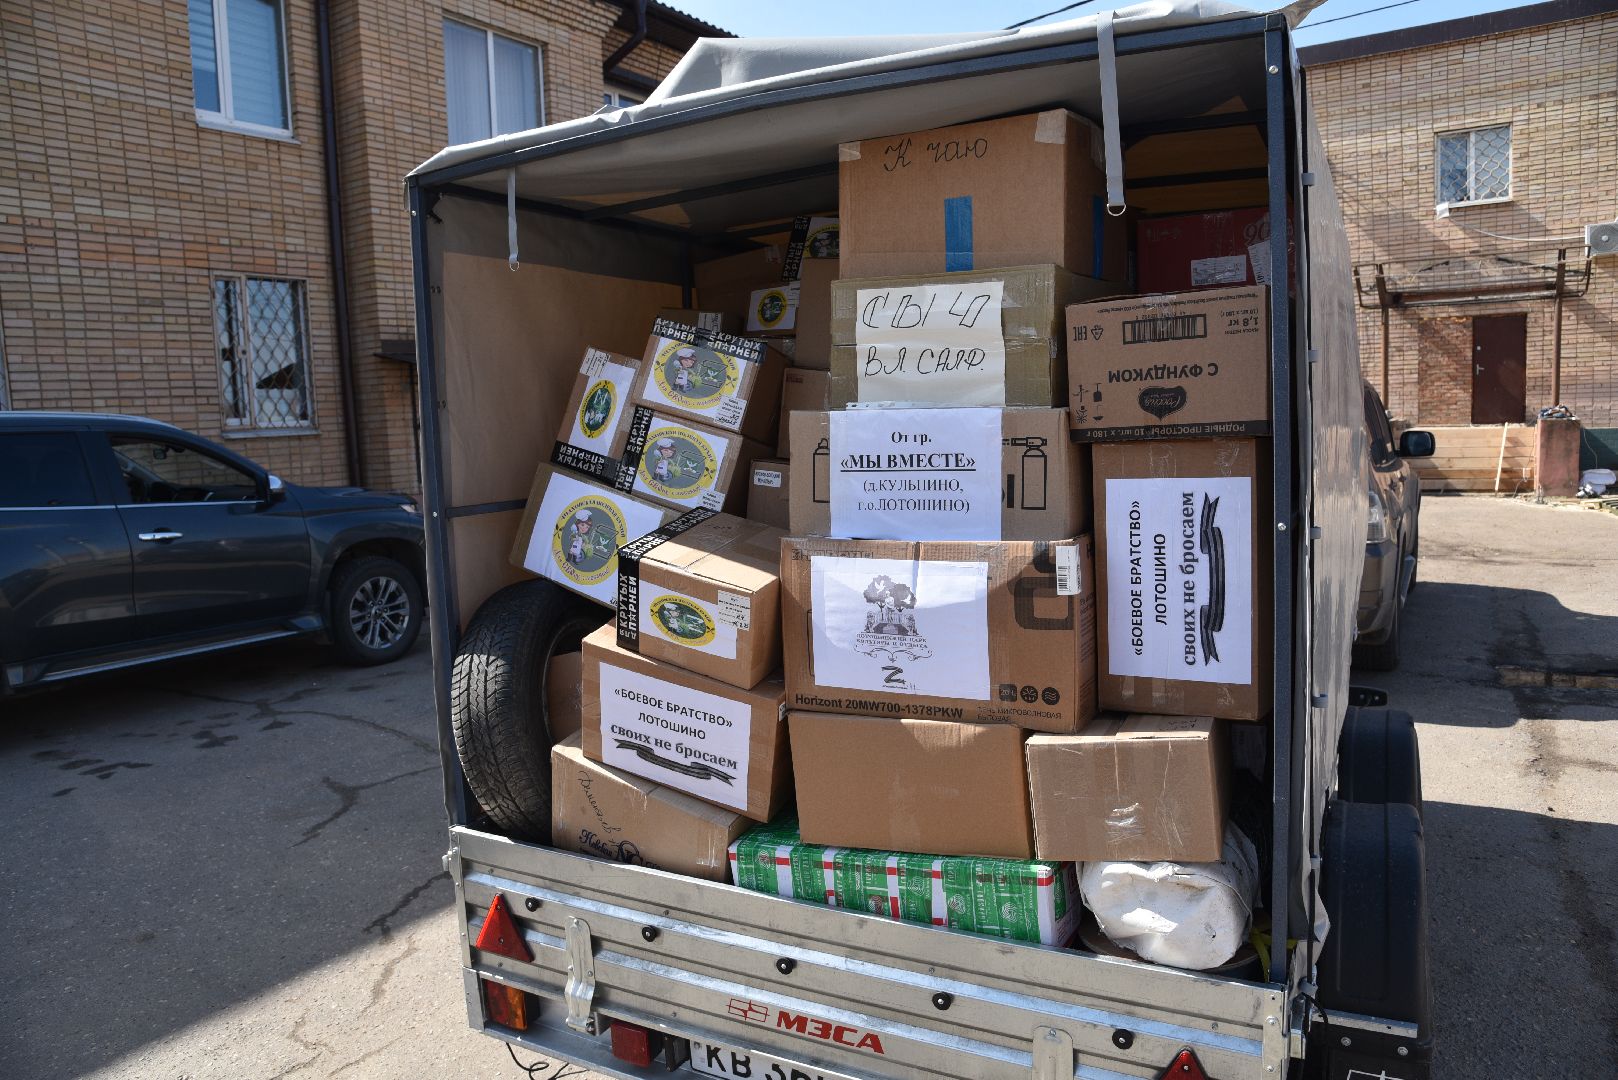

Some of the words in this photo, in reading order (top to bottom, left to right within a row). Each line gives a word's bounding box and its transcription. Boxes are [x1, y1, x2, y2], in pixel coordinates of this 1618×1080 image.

[884, 137, 912, 172] К
[927, 138, 988, 163] чаю
[1242, 314, 1259, 327] 1,8
[1108, 363, 1204, 384] ФУНДУКОМ
[1207, 362, 1219, 377] С
[891, 431, 906, 443] От
[913, 432, 932, 446] гр.
[1152, 424, 1203, 436] ПРОСТОРЫ
[1205, 423, 1246, 434] РОДНЫЕ
[840, 453, 881, 469] «МЫ
[887, 452, 976, 469] ВМЕСТЕ»
[1129, 500, 1142, 585] БРАТСТВО»
[1178, 491, 1199, 575] бросаем
[1153, 533, 1167, 625] ЛОТОШИНО
[1183, 581, 1195, 604] не
[619, 573, 628, 628] КРУТЫХ
[1130, 589, 1143, 656] «БОЕВОЕ
[1183, 608, 1196, 666] своих
[614, 687, 663, 710] «БОЕВОЕ
[666, 701, 733, 728] БРАТСТВО»
[795, 693, 842, 709] Horizont
[845, 698, 964, 719] 20MW700-1378PKW
[997, 708, 1062, 720] МИКРОВОЛНОВАЯ
[638, 711, 706, 740] ЛОТОШИНО
[611, 723, 651, 745] своих
[654, 737, 672, 750] не
[675, 742, 738, 770] бросаем
[776, 1010, 885, 1055] МЗСА
